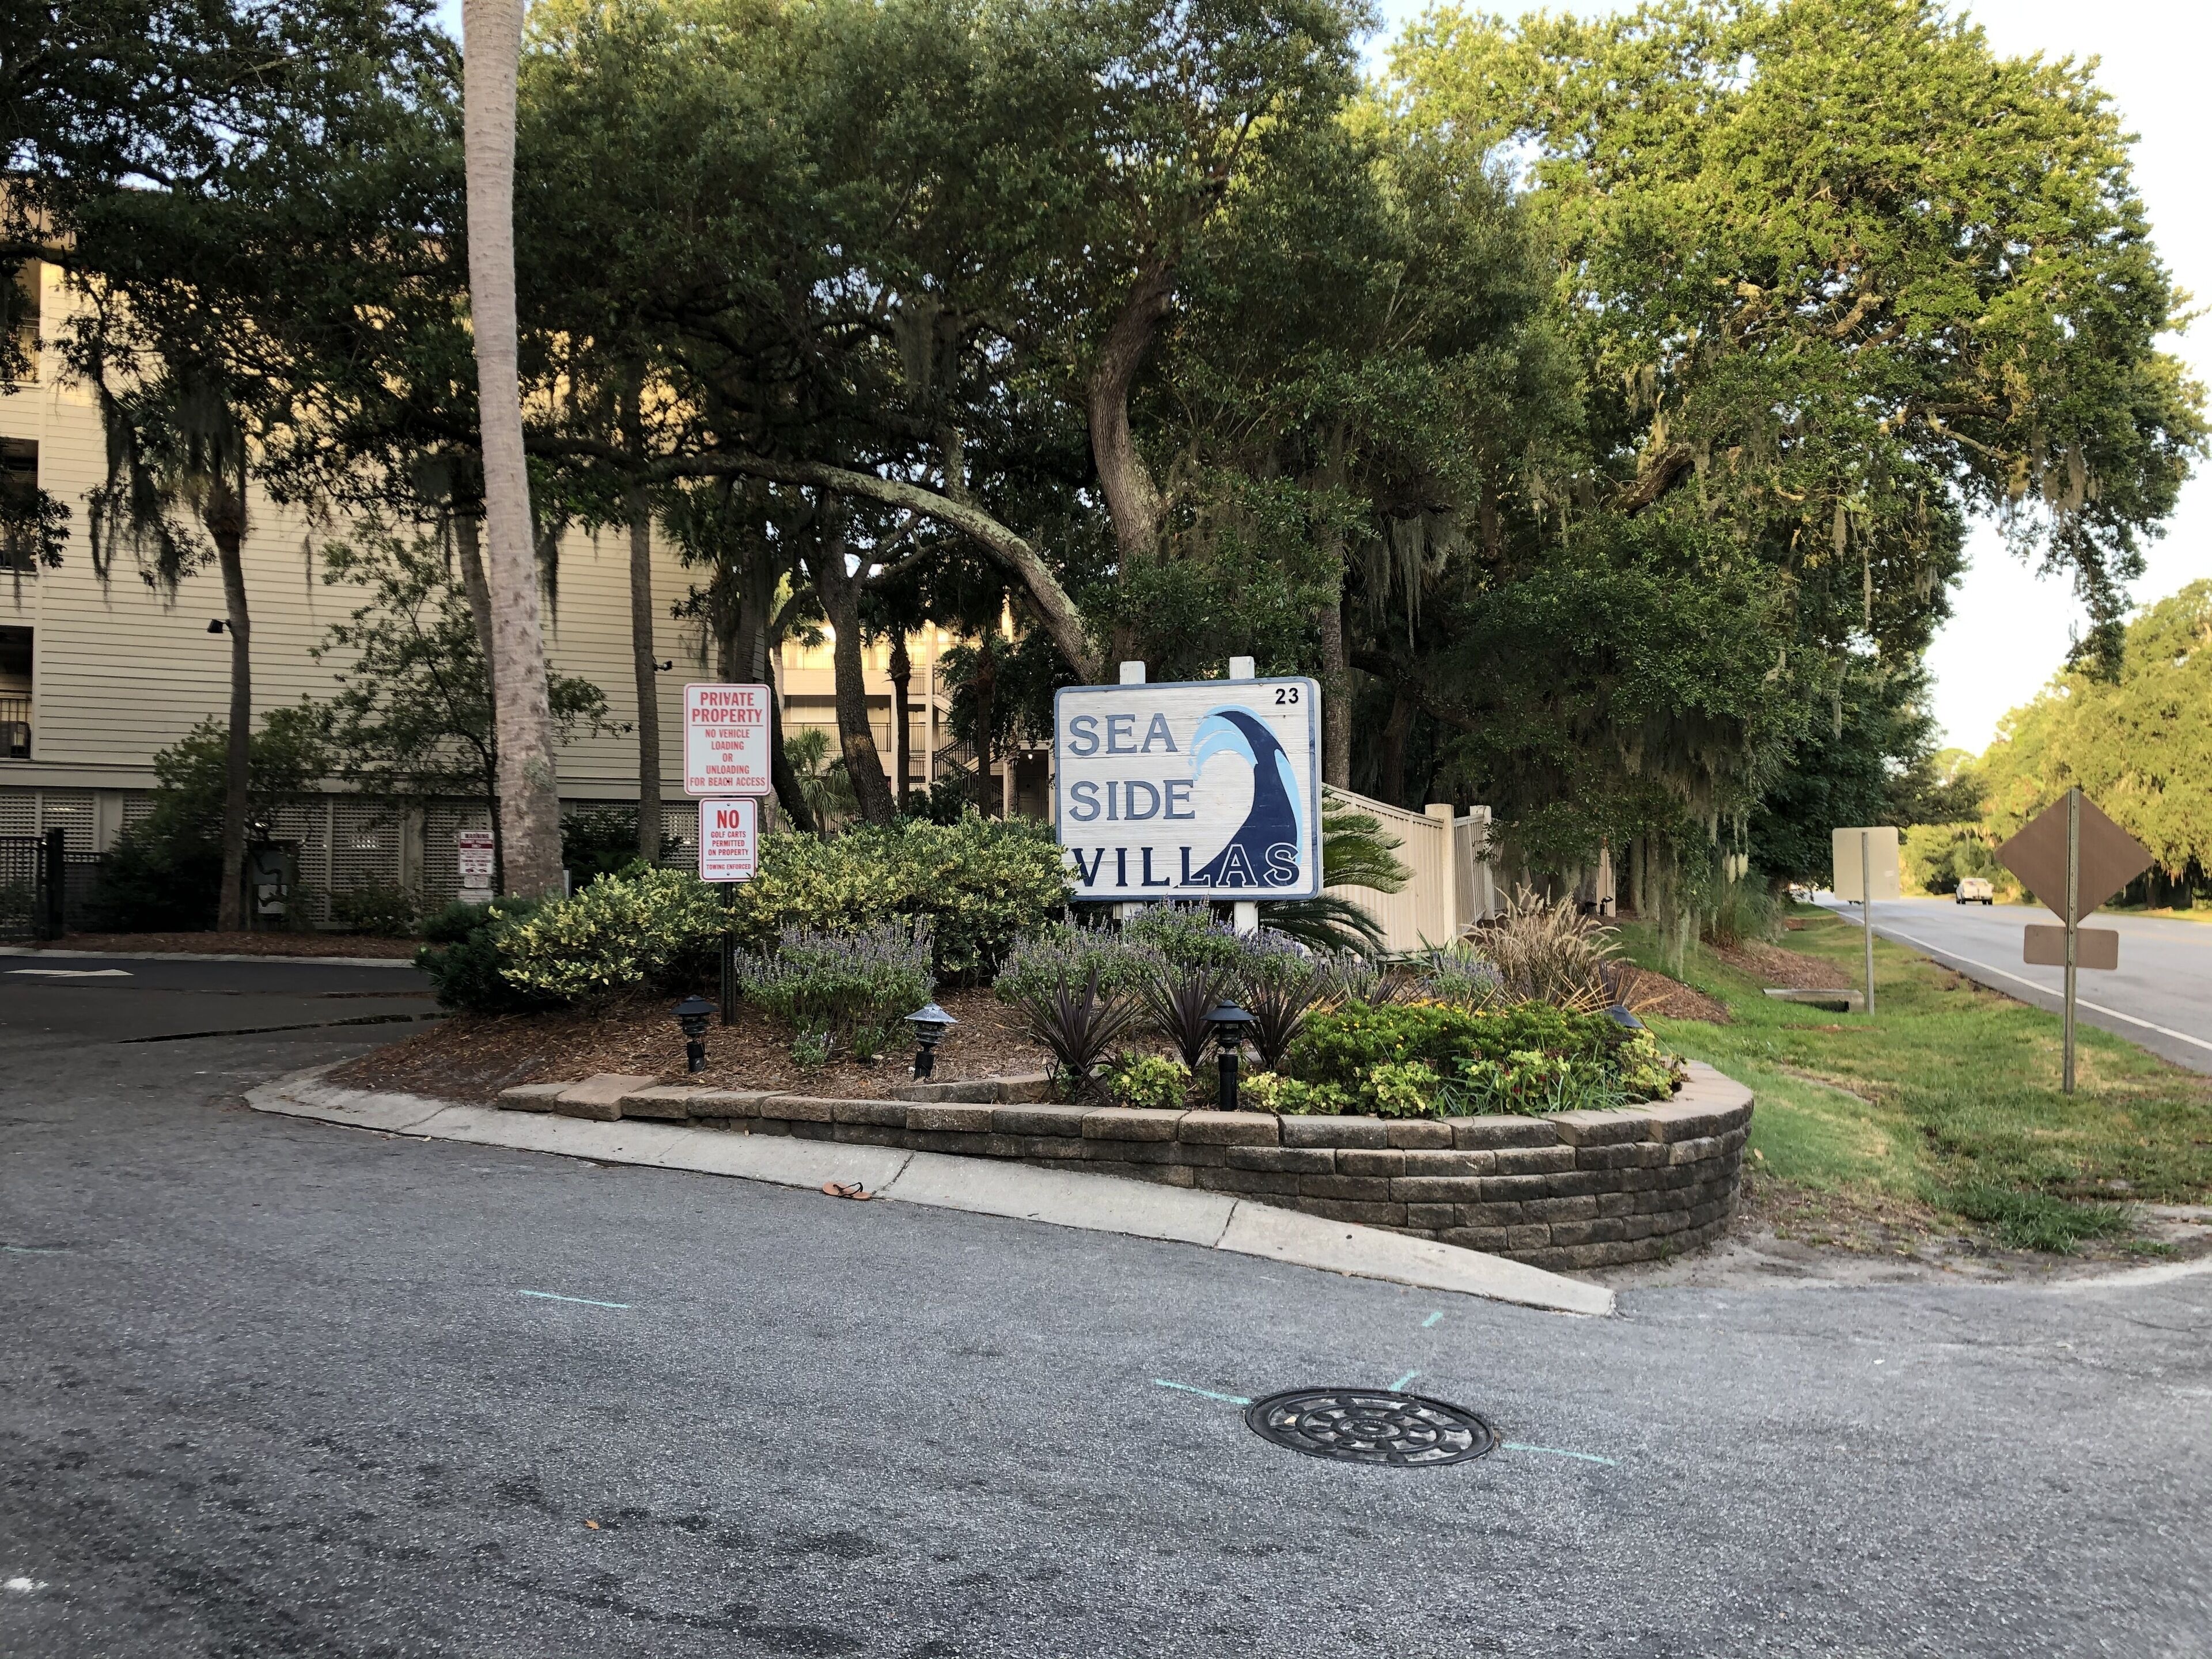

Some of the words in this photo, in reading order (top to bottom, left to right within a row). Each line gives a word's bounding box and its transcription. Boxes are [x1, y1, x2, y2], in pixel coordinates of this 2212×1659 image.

[700, 692, 755, 706] PRIVATE
[1275, 687, 1300, 704] 23
[692, 709, 763, 723] PROPERTY
[704, 729, 716, 738] NO
[719, 729, 750, 738] VEHICLE
[1067, 712, 1179, 756] SEA
[711, 741, 744, 750] LOADING
[722, 753, 733, 762] OR
[706, 766, 749, 774] UNLOADING
[690, 778, 705, 786] FOR
[708, 778, 733, 786] BEACH
[736, 778, 766, 786] ACCESS
[1069, 779, 1196, 822] SIDE
[717, 810, 740, 828] NO
[1071, 842, 1301, 889] VILLAS
